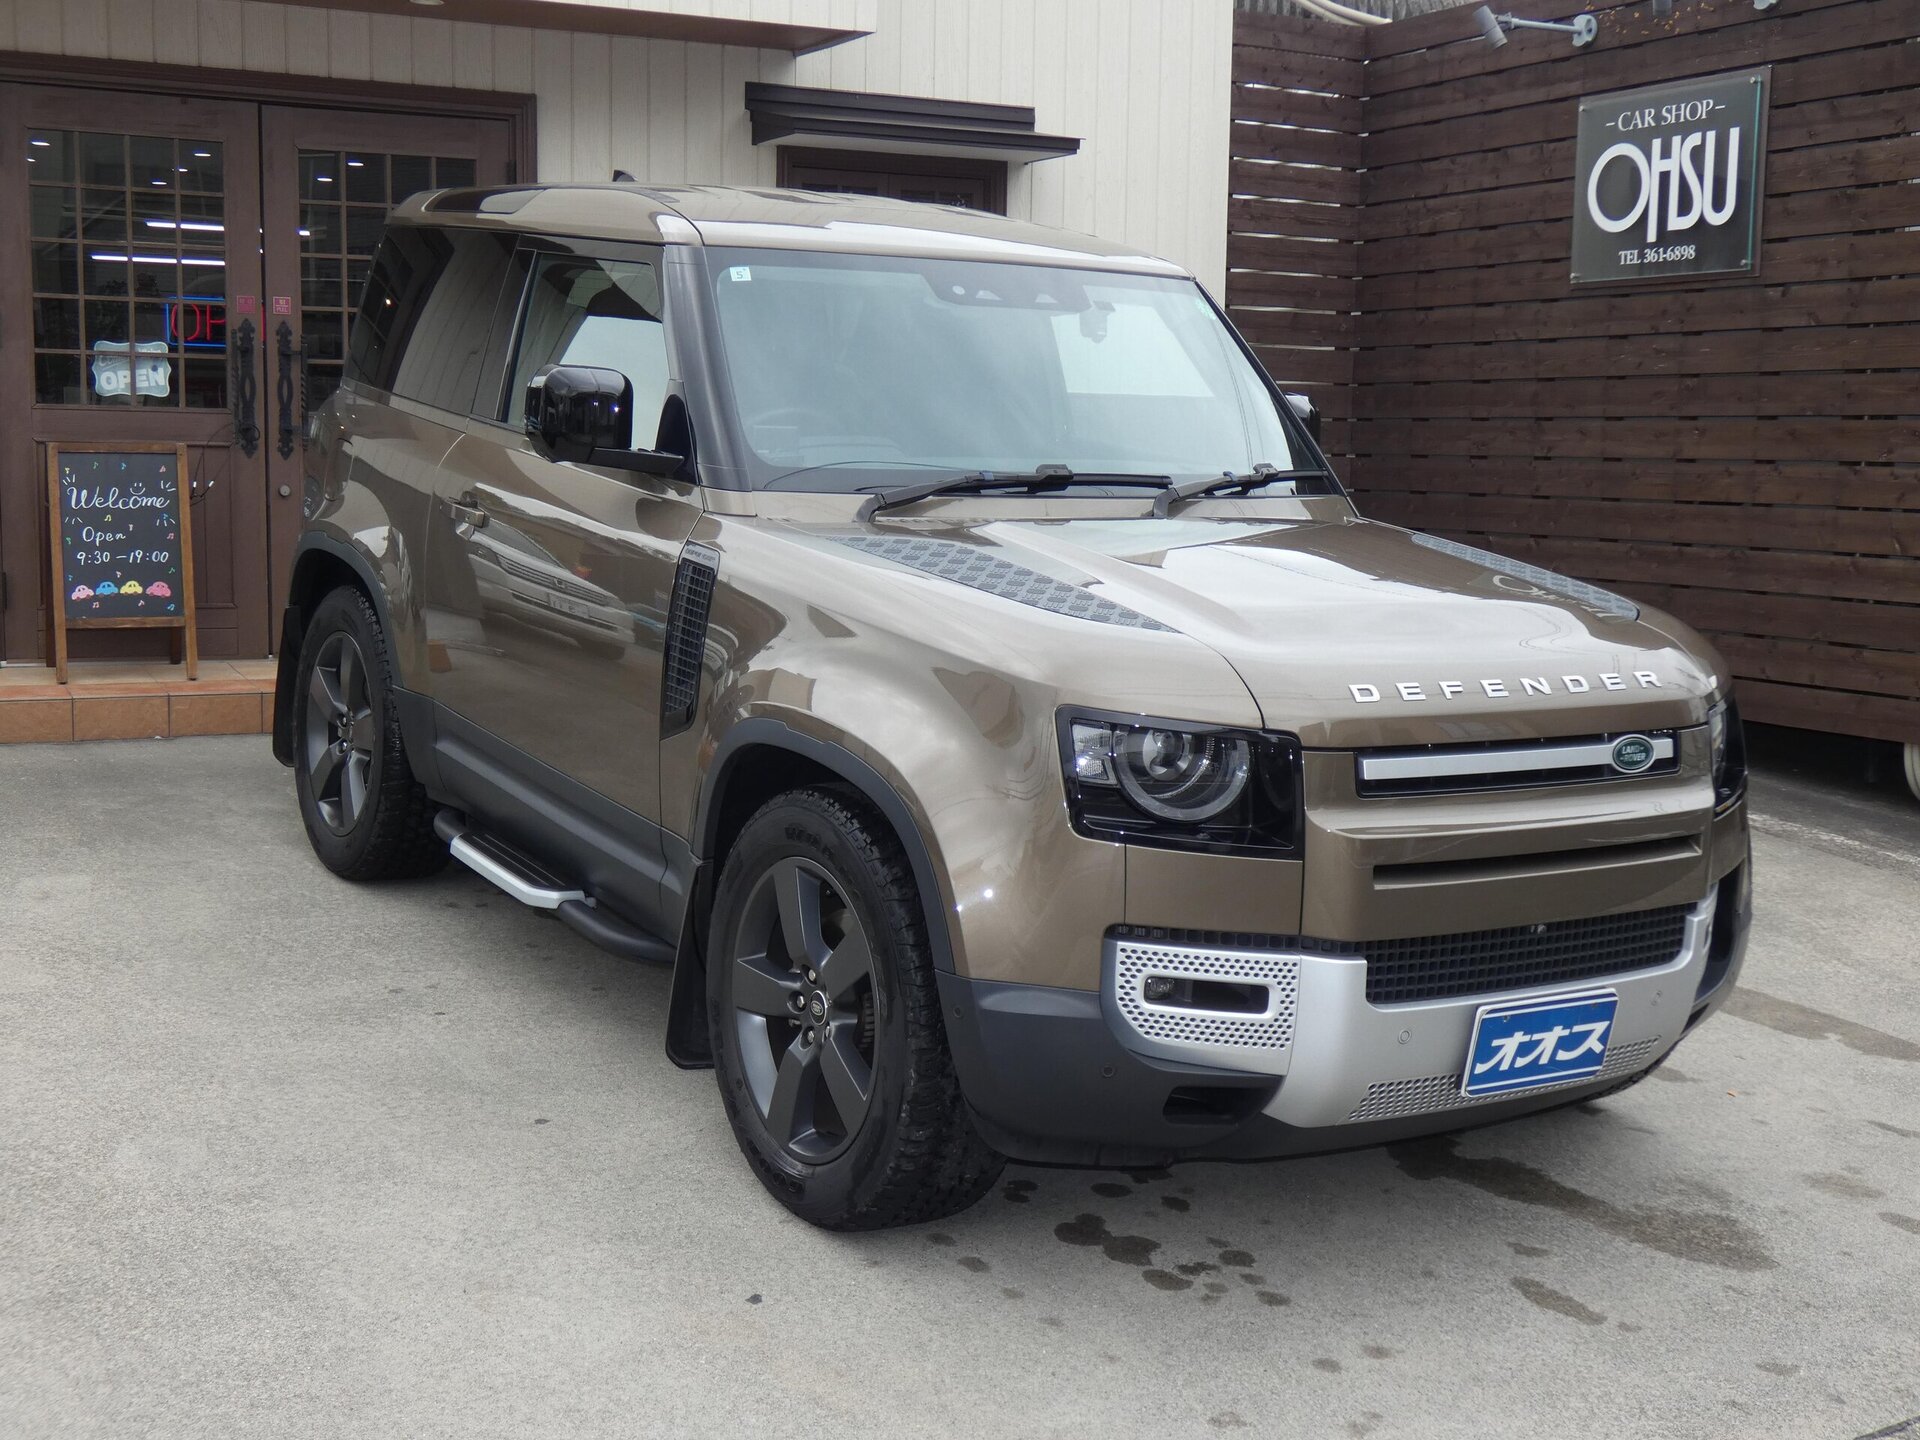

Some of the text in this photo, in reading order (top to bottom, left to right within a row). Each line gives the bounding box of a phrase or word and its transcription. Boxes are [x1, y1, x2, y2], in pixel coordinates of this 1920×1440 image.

[1587, 126, 1741, 243] OHSU
[1618, 245, 1696, 265] TEL 361-6898
[100, 368, 165, 390] OPEN
[66, 486, 169, 509] Welcome
[82, 526, 126, 546] Open
[1348, 670, 1663, 703] DEFENDER
[1474, 1021, 1610, 1074] オオス
